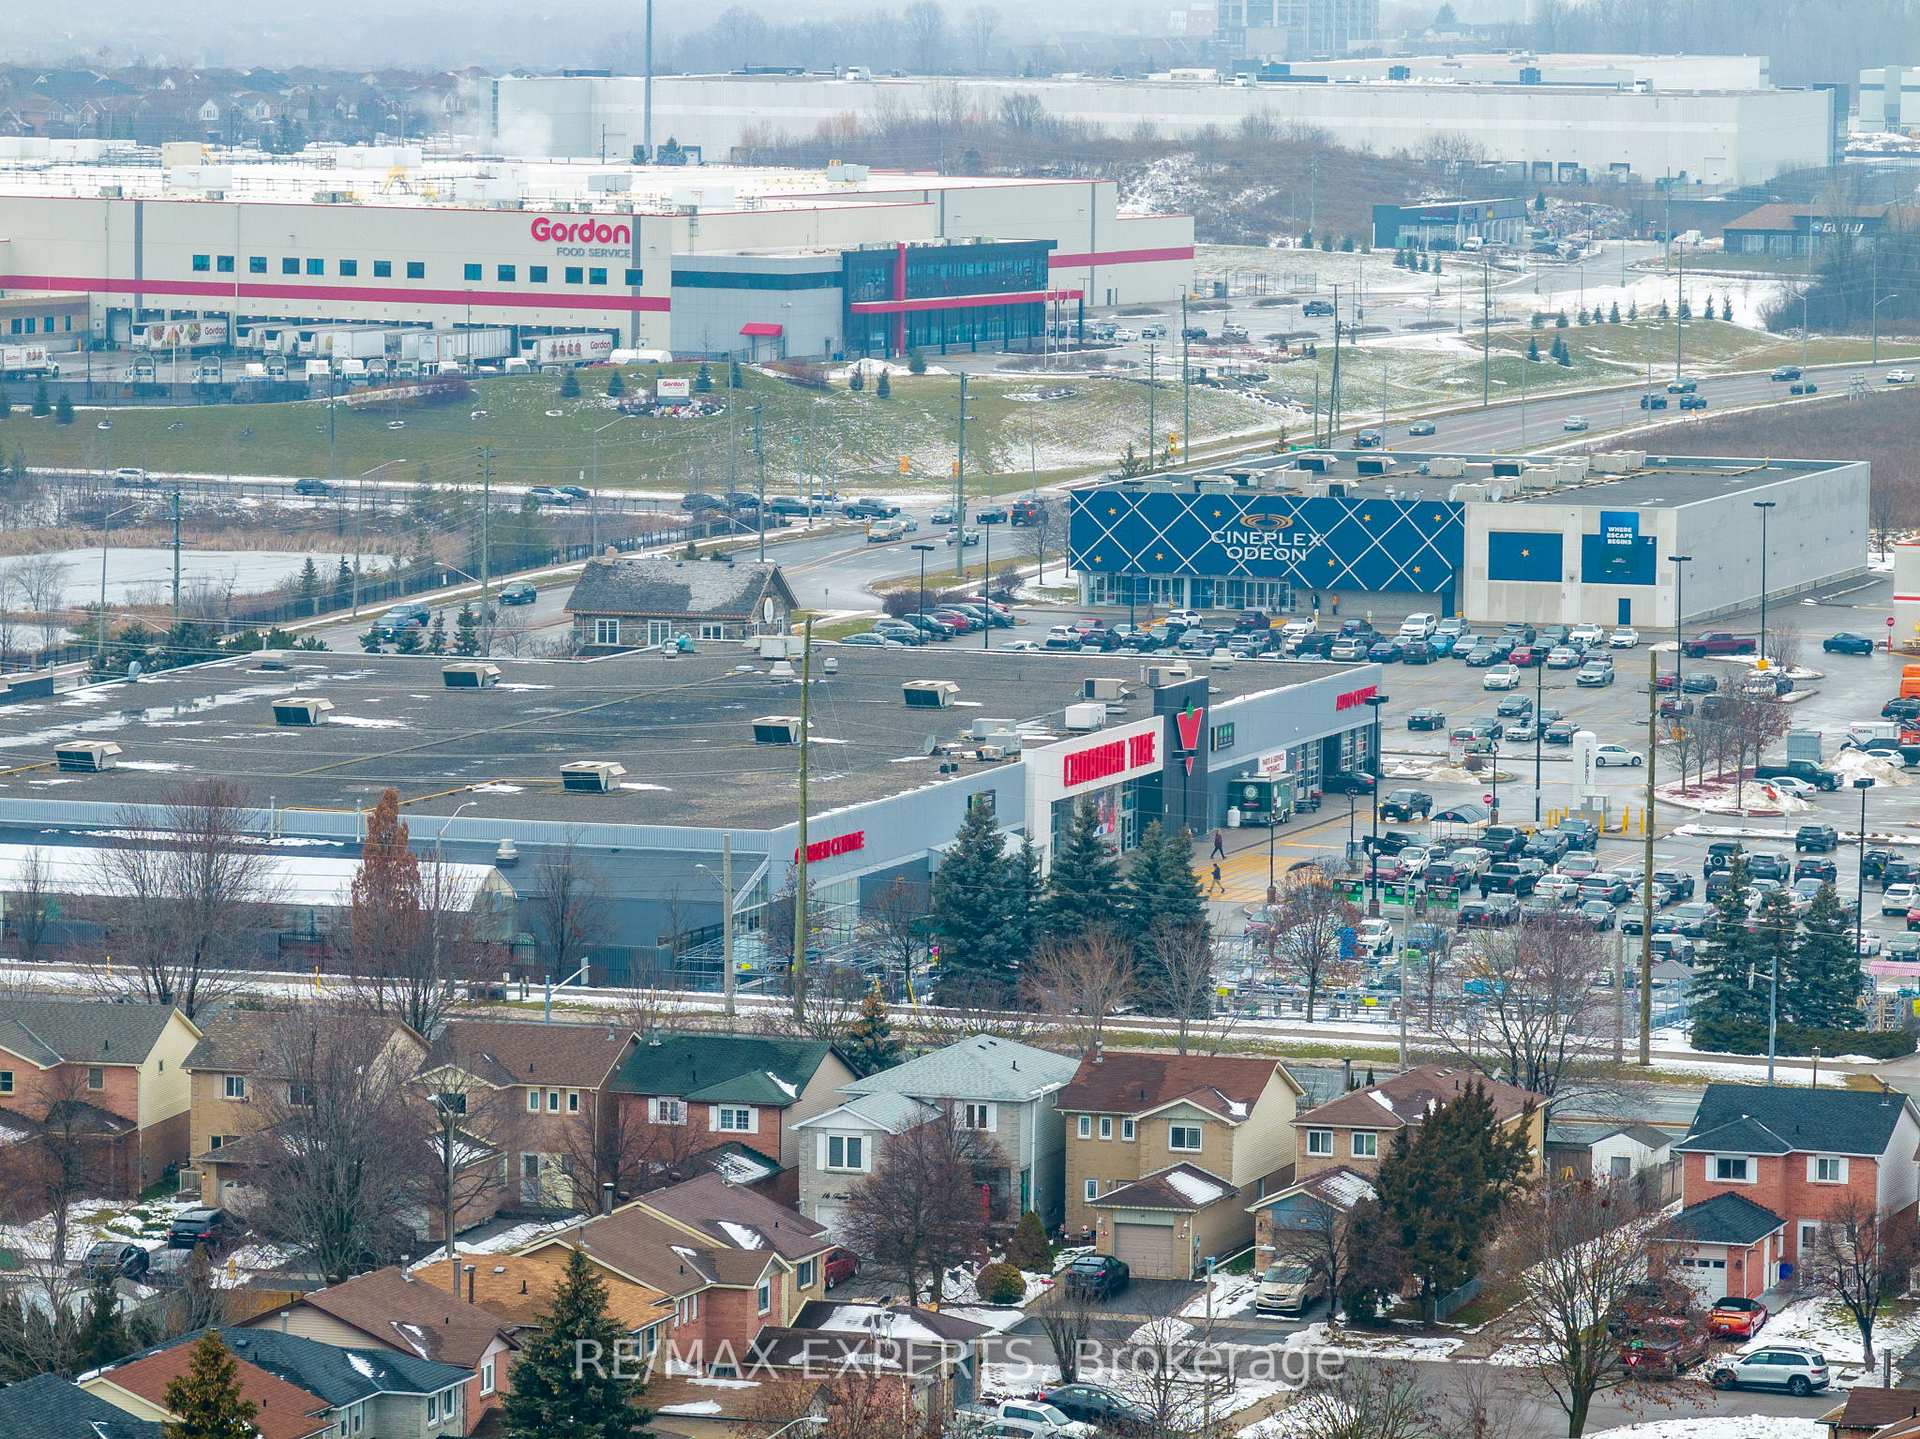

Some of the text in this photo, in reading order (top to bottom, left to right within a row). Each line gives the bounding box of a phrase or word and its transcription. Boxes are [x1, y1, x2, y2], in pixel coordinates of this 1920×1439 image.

[531, 217, 631, 243] Gordon
[557, 247, 630, 258] FOOD SERVICE
[590, 339, 611, 350] Gordon
[1211, 531, 1322, 546] CINEPLEX
[1226, 546, 1306, 561] ODEON
[1063, 730, 1156, 788] CANADIAN TIRE
[794, 840, 831, 865] GRDEN
